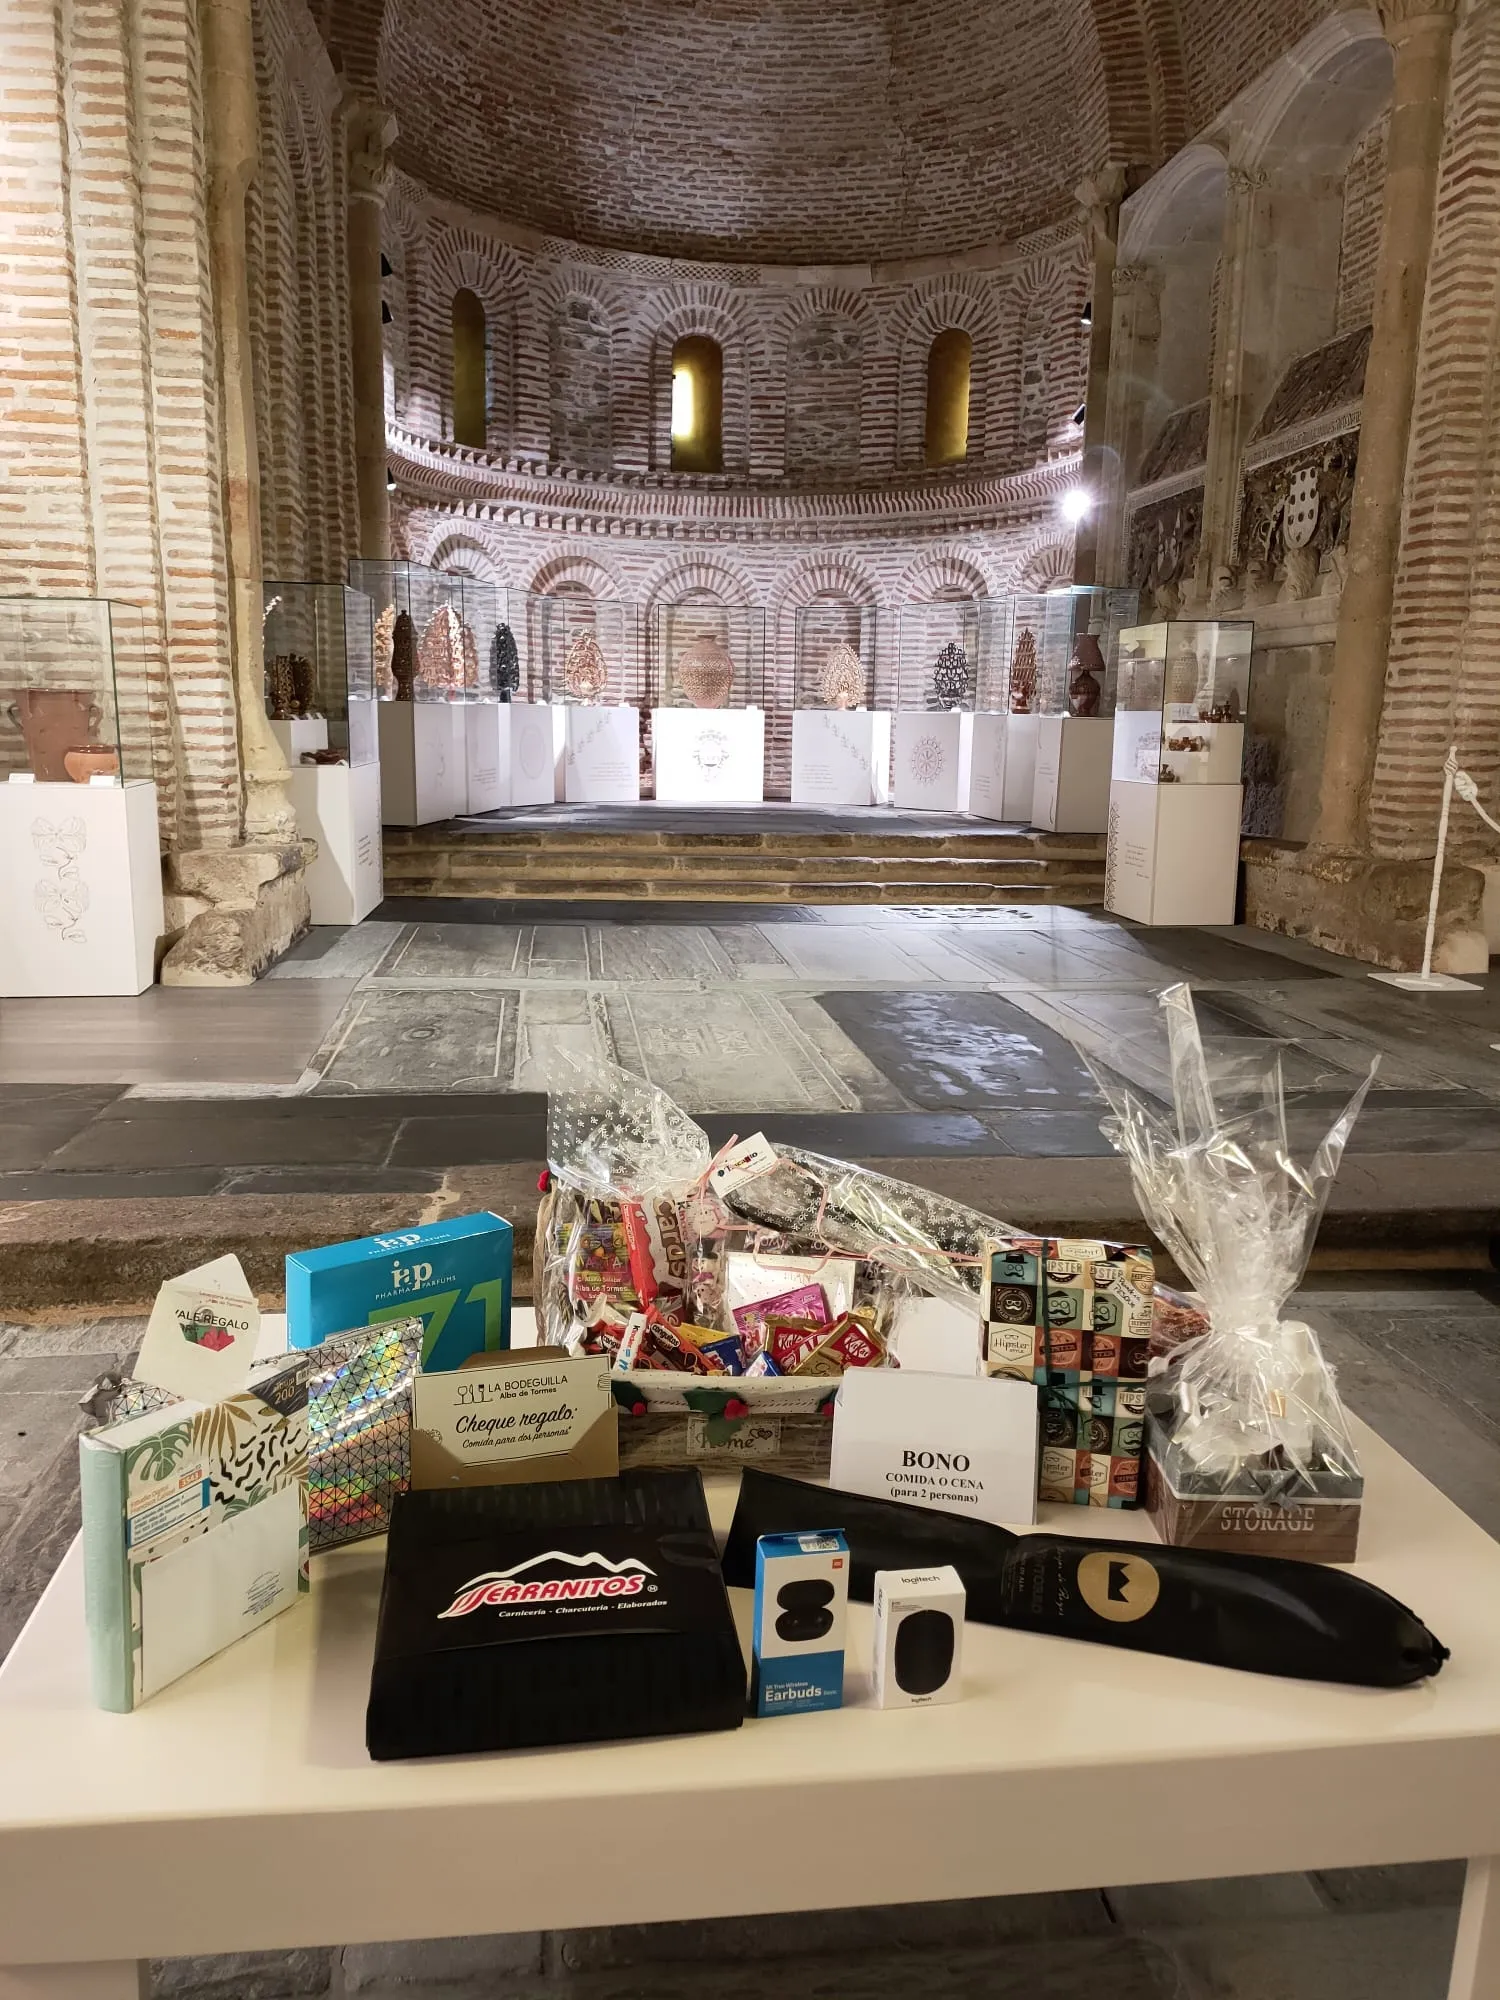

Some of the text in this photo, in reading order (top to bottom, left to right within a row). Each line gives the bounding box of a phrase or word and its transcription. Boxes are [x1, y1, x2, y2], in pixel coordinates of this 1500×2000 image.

[375, 1275, 457, 1301] PHARMA PARFUMS
[175, 1309, 200, 1322] ALE
[203, 1314, 249, 1331] REGALO
[651, 1323, 680, 1348] conguitos
[994, 1338, 1029, 1352] Hipster
[488, 1375, 568, 1393] LA BODEGUILLA
[500, 1387, 557, 1400] Alba de Tormes
[456, 1414, 516, 1436] Cheque
[462, 1437, 494, 1449] Comida
[494, 1436, 515, 1447] para
[518, 1432, 532, 1443] dos
[902, 1450, 970, 1472] BONO
[885, 1472, 984, 1491] COMIDA O CENA
[890, 1486, 979, 1505] (para 2 personas)
[1220, 1506, 1315, 1532] STORAGE
[901, 1575, 941, 1585] logitech
[499, 1609, 546, 1618] Carnicería
[617, 1599, 668, 1610] Elaborados
[765, 1686, 822, 1702] Earbuds
